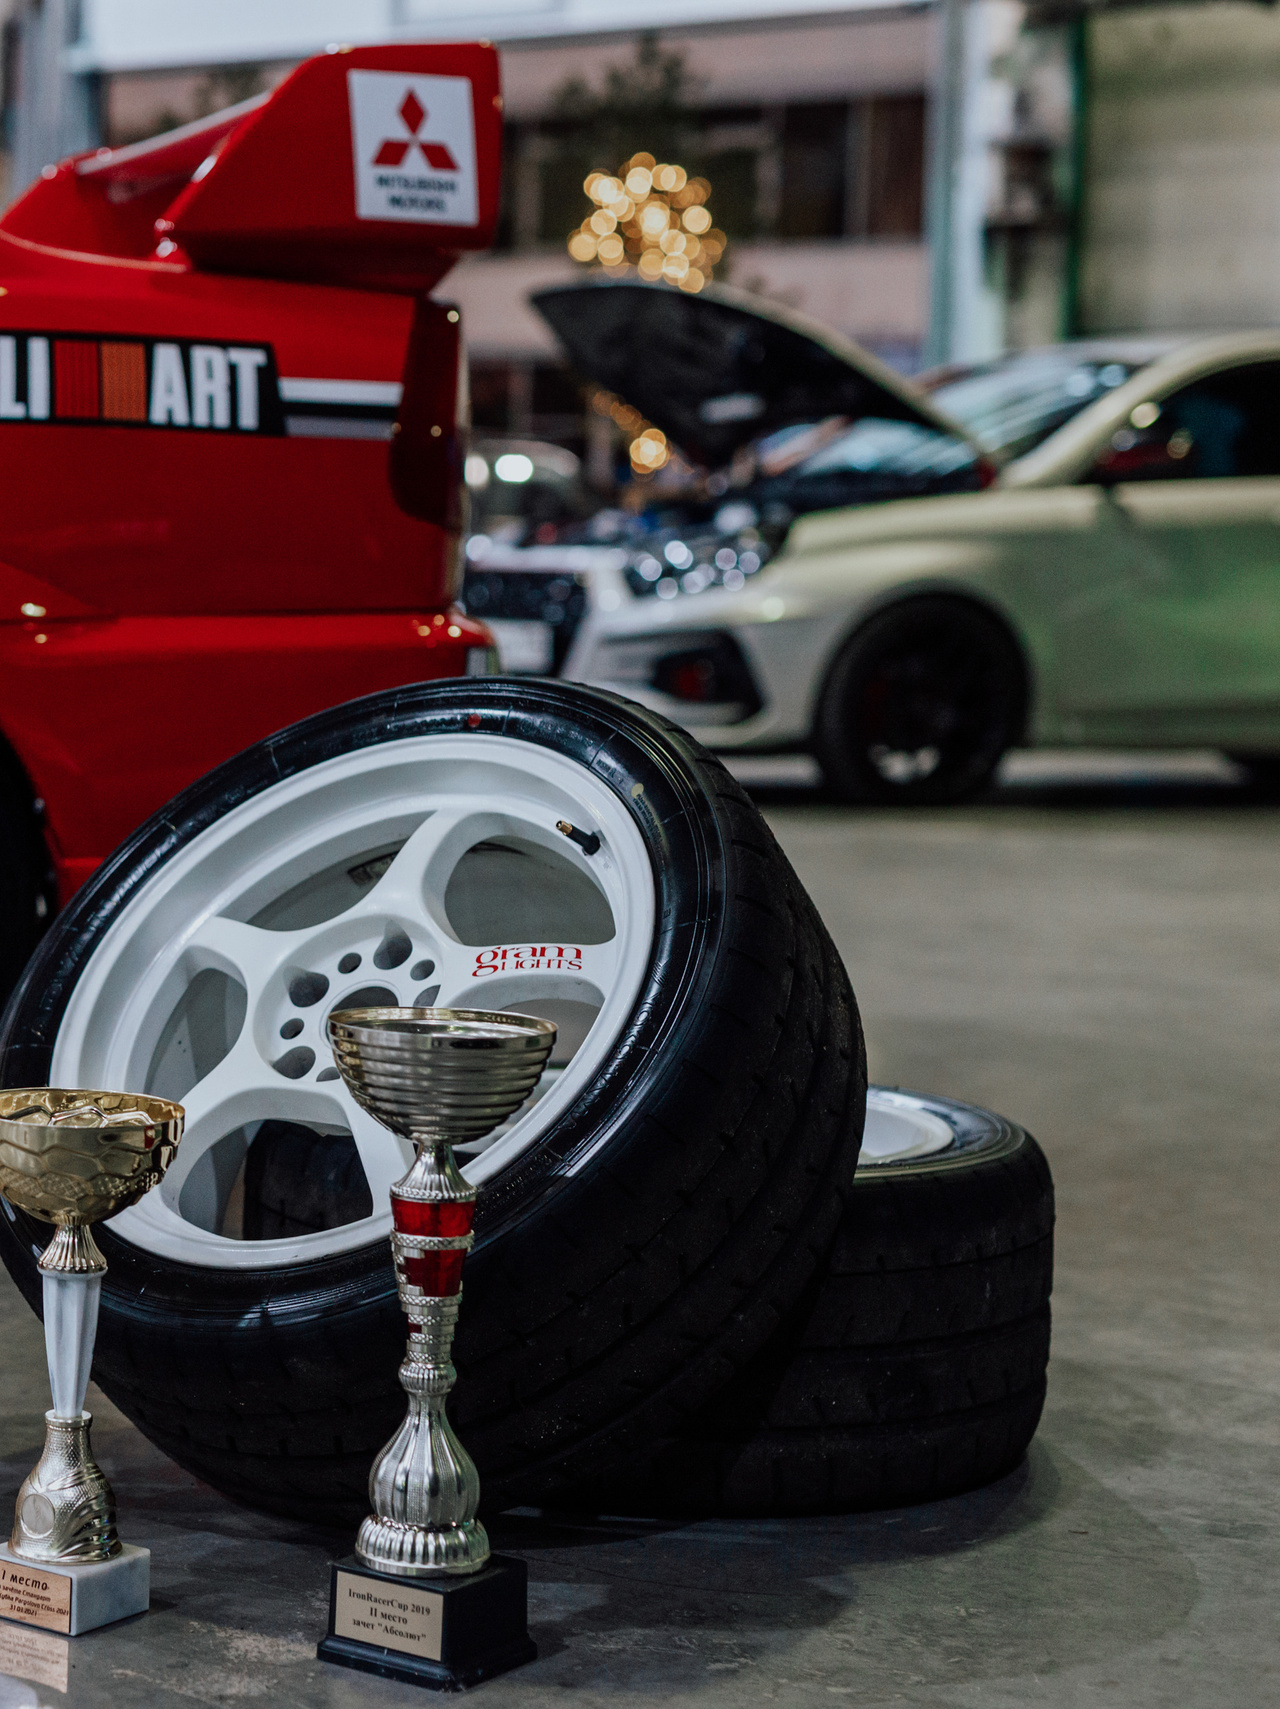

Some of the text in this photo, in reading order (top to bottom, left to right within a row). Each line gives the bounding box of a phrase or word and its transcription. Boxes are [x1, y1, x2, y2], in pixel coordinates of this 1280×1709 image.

[149, 342, 267, 430] ART
[472, 945, 583, 977] gram
[348, 1588, 431, 1617] IronRacerCup 2019
[352, 1617, 427, 1643] зачет "Абсолют"
[380, 1611, 408, 1625] место
